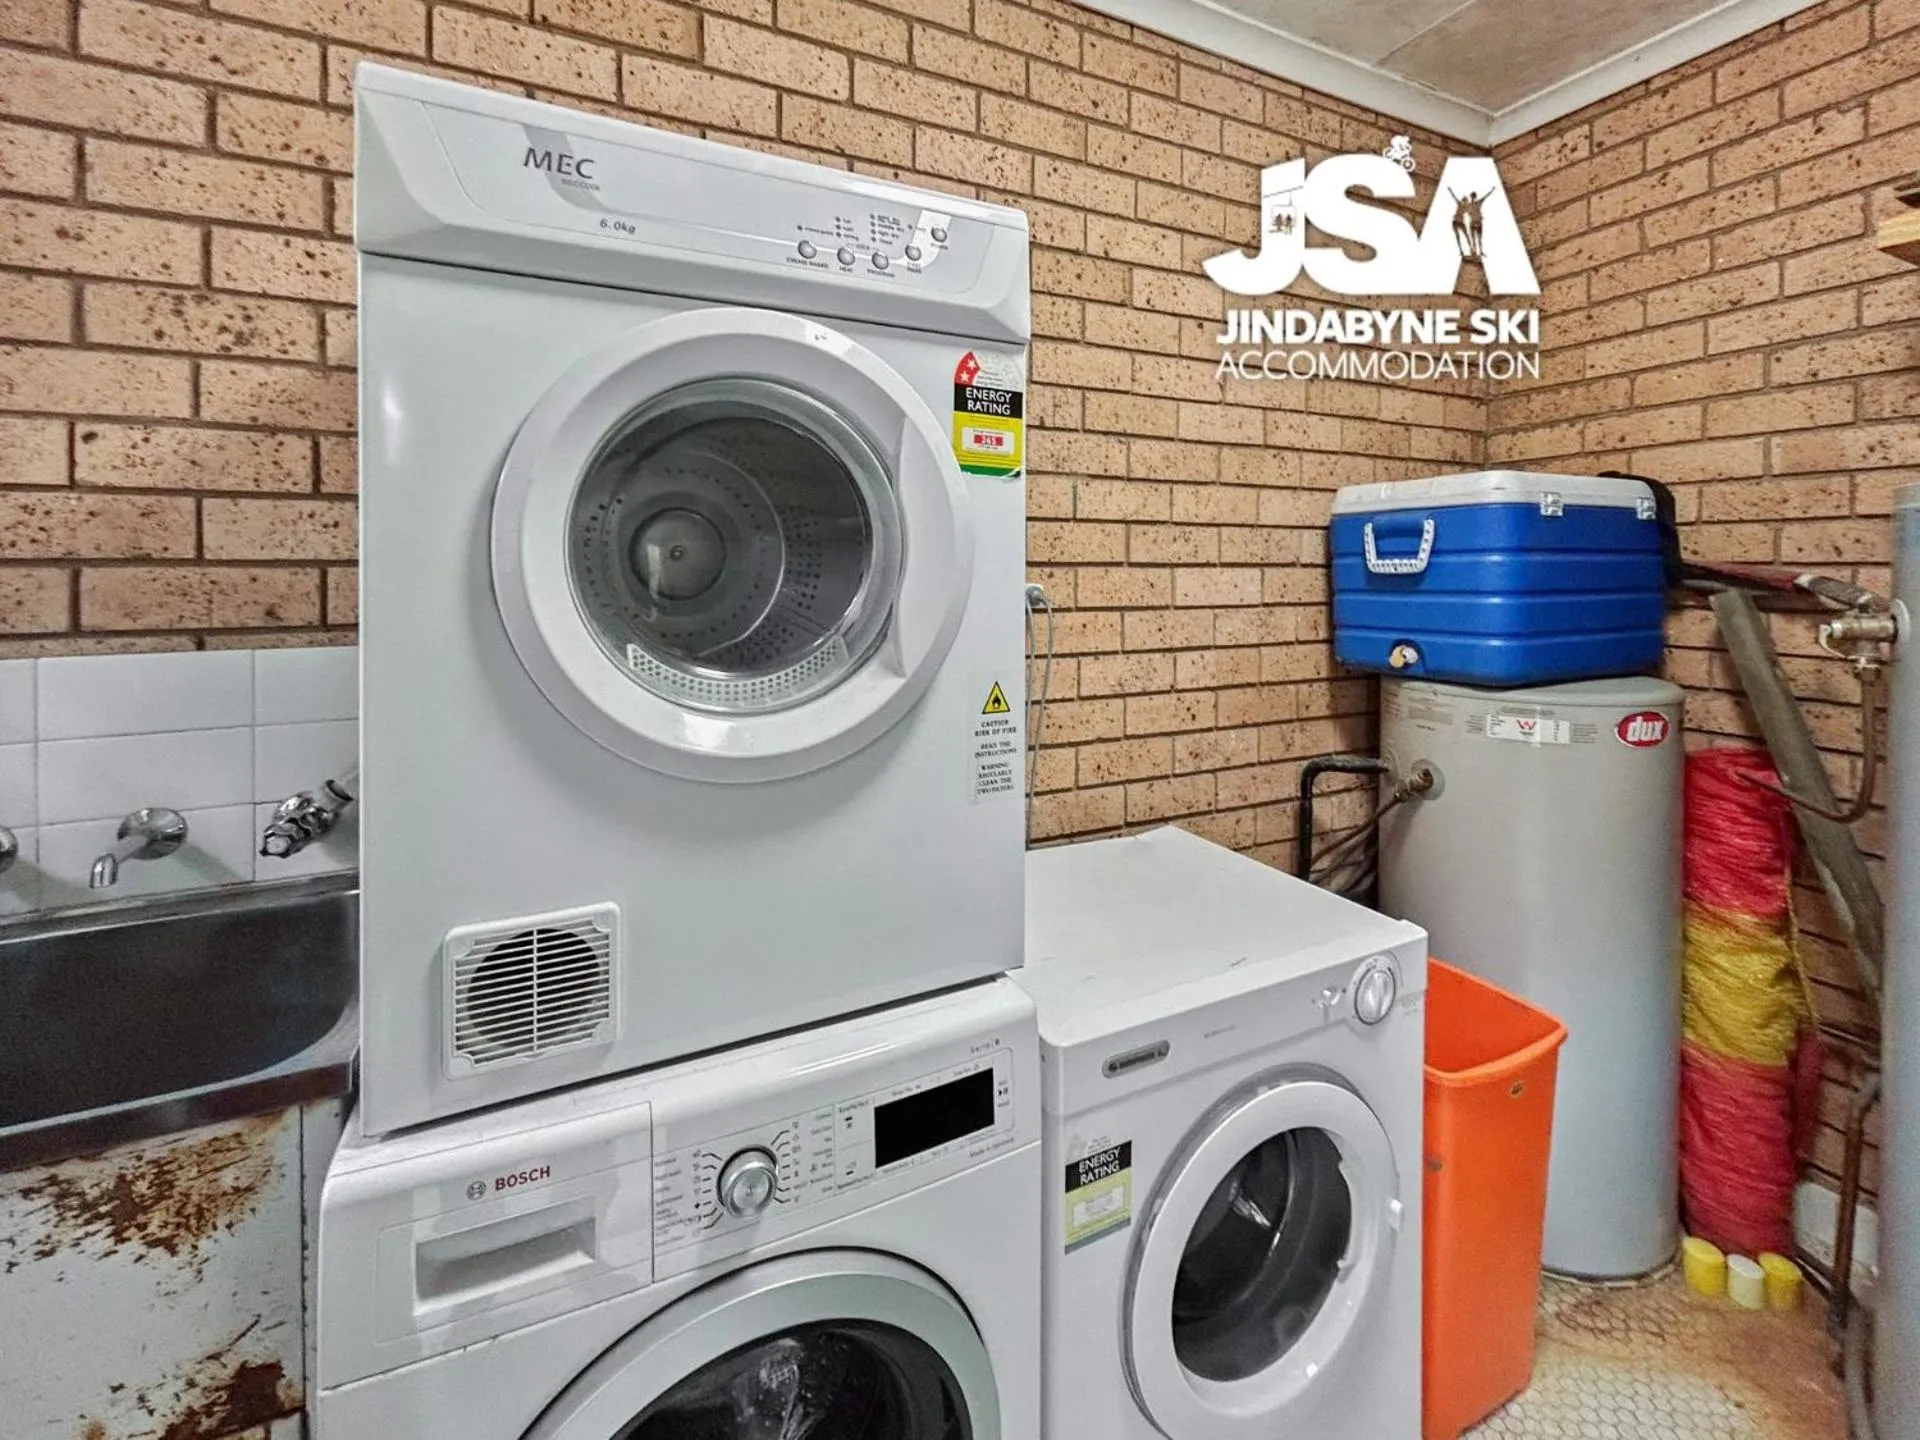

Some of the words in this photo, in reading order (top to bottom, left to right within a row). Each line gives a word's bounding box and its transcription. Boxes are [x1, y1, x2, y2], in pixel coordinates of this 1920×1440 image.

[523, 147, 596, 179] MEC
[965, 388, 1012, 403] ENERGY
[967, 401, 1011, 415] RATING
[981, 719, 1009, 728] CAUTION
[1626, 716, 1663, 741] dux
[1079, 1147, 1121, 1173] ENERGY
[494, 1165, 551, 1192] BOSCH
[1080, 1163, 1120, 1186] RATING
